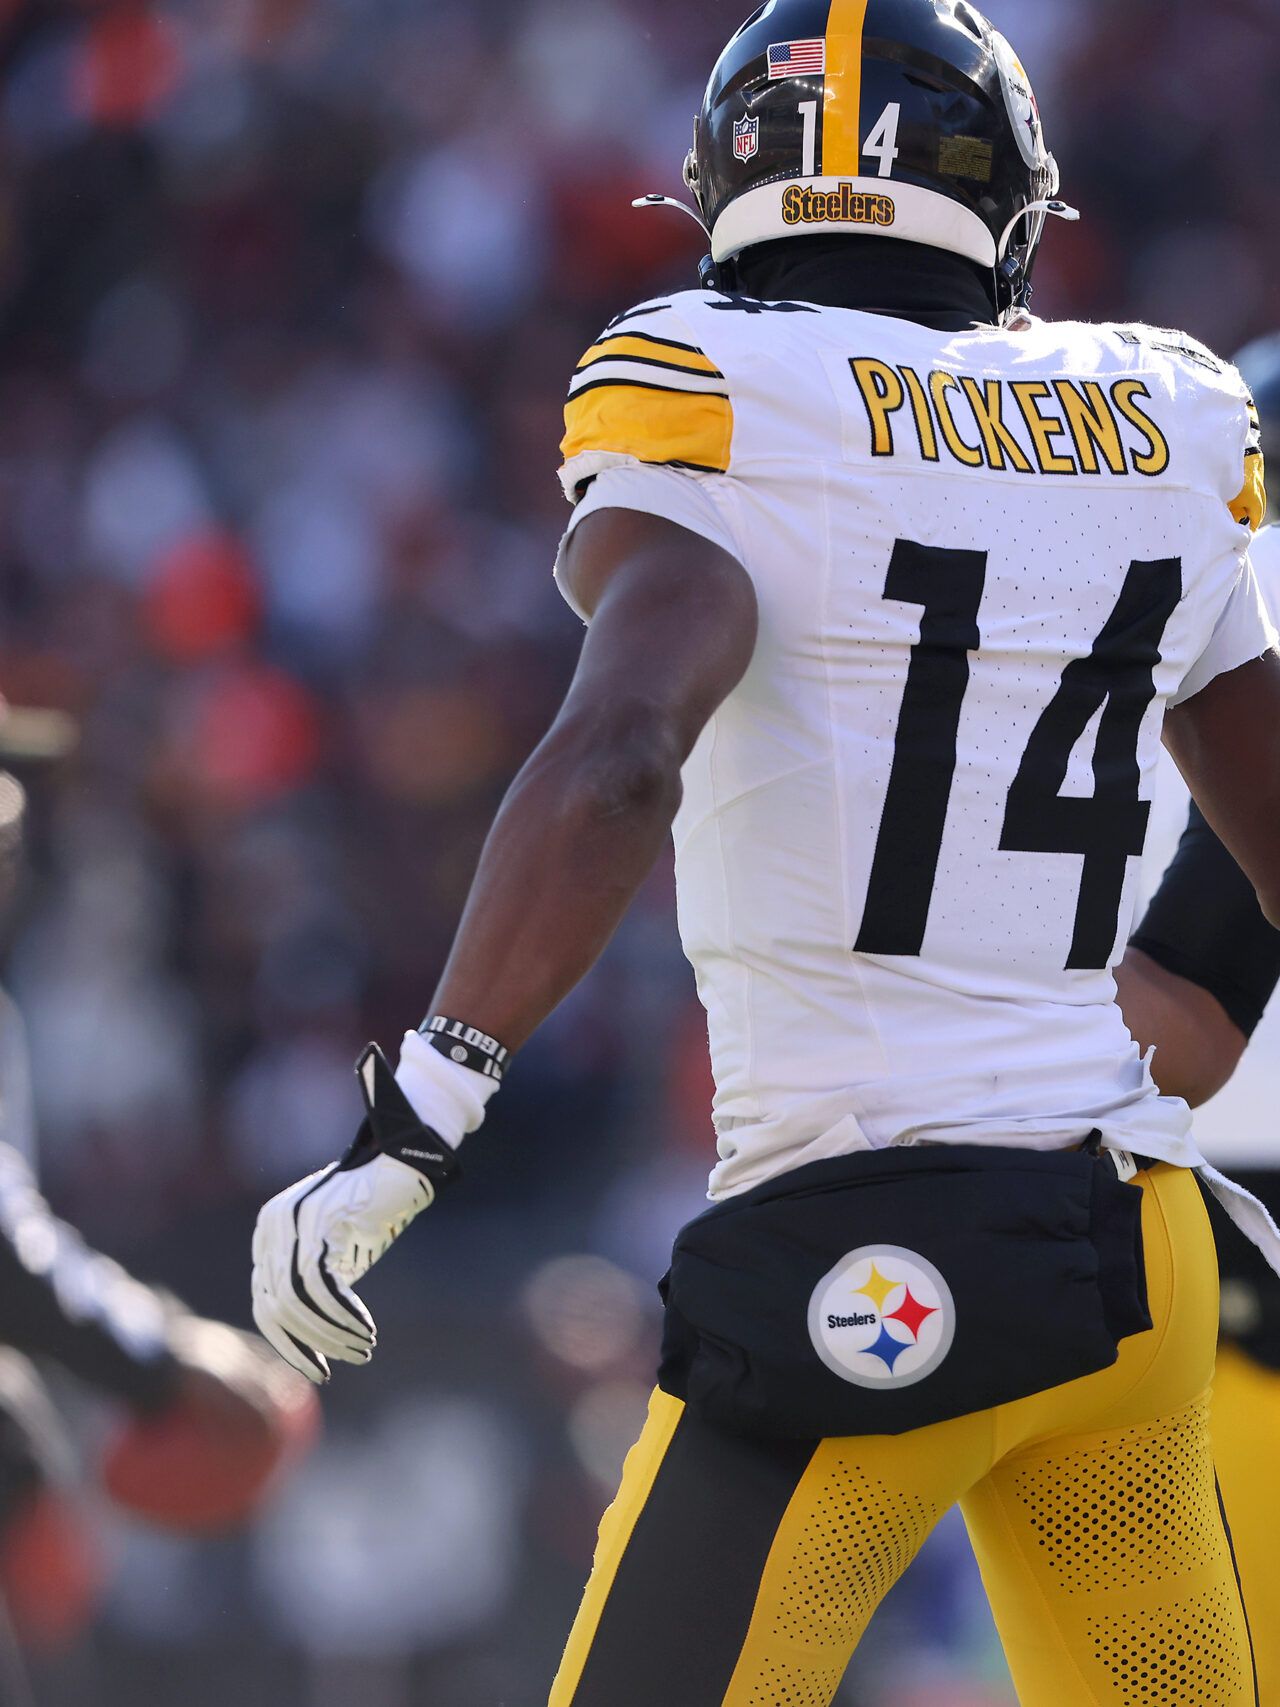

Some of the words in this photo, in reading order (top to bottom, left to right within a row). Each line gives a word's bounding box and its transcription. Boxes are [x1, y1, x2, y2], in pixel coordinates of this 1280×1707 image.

[736, 138, 754, 156] NFL
[781, 182, 895, 226] Steelers
[847, 356, 1171, 477] PICKENS
[853, 539, 1183, 971] 14
[828, 1312, 876, 1328] Steelers
